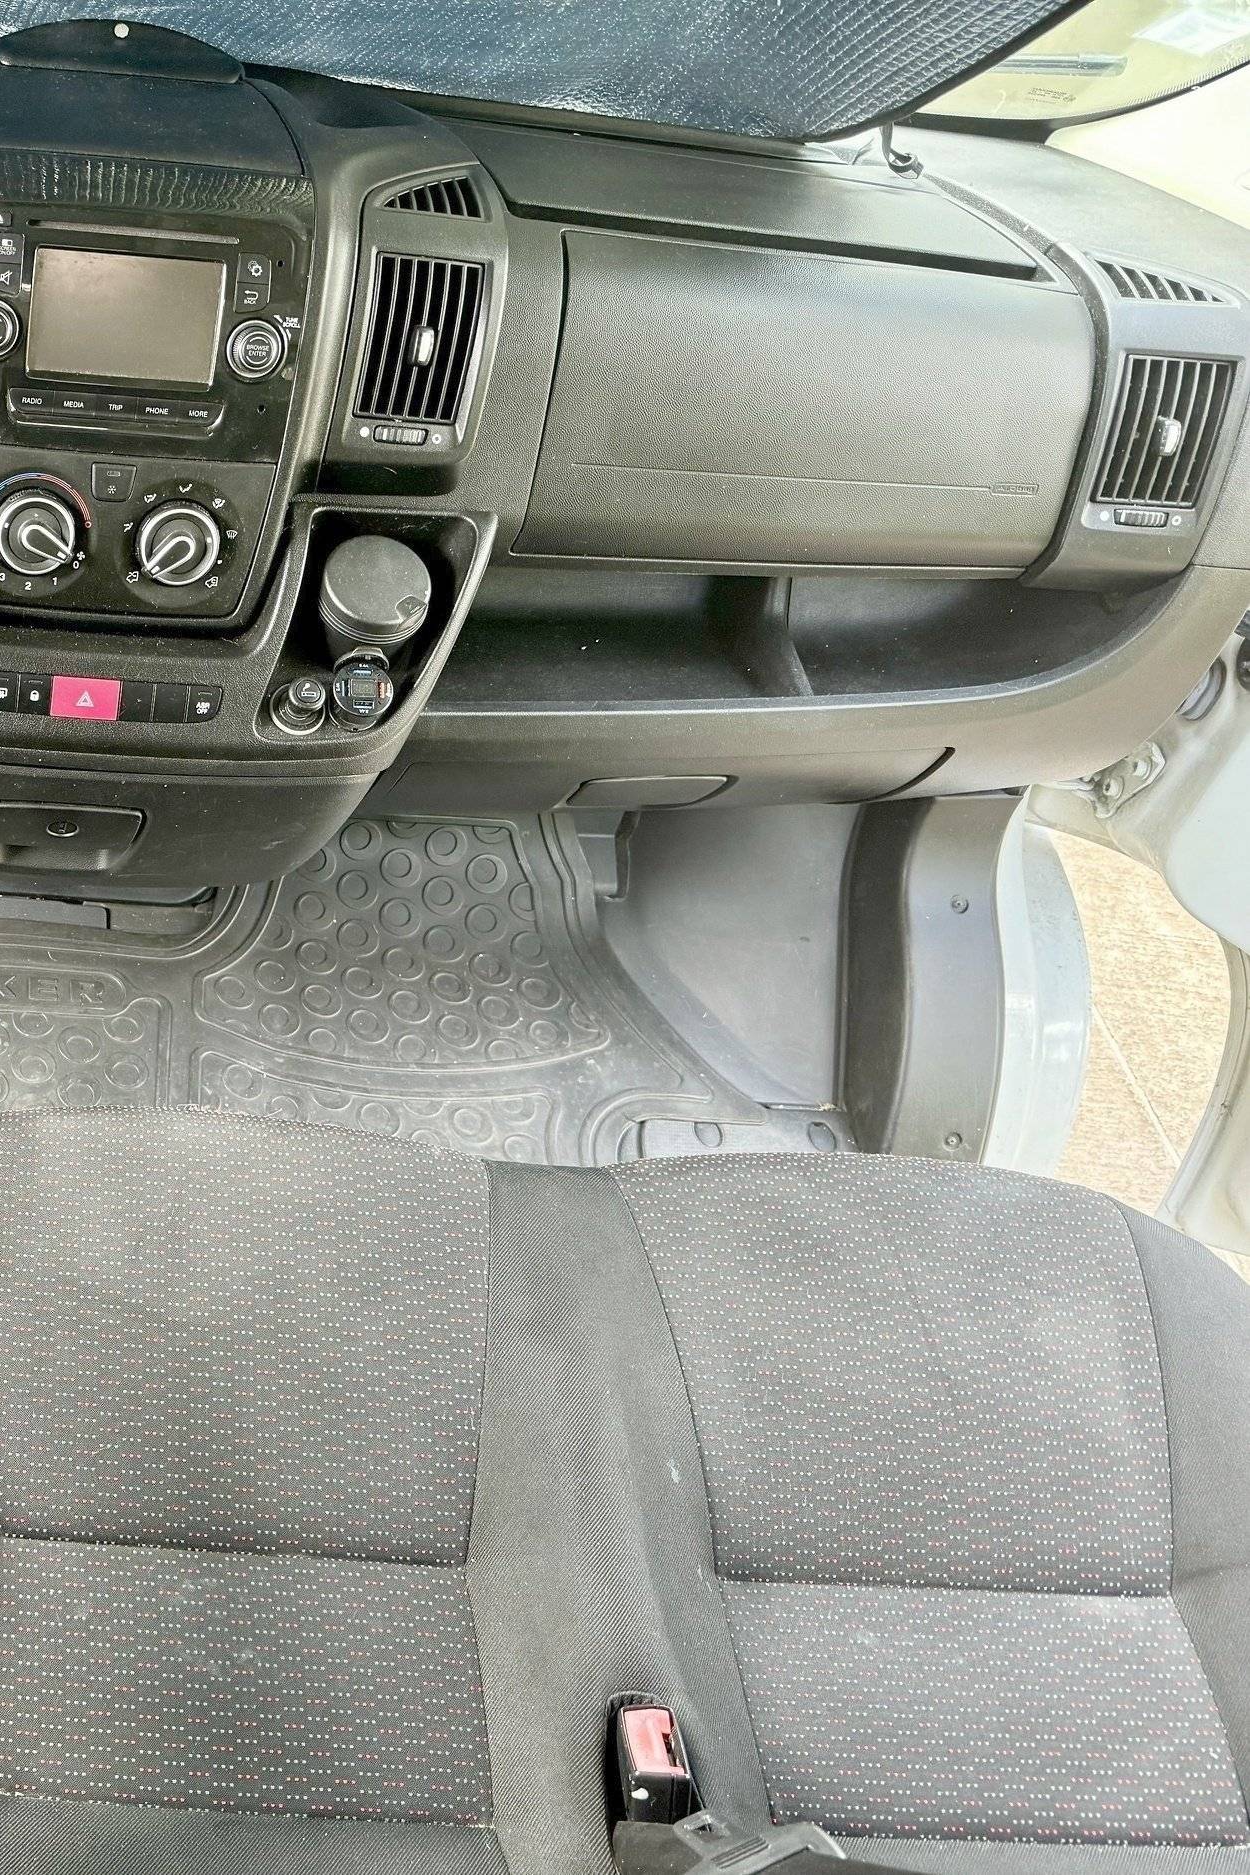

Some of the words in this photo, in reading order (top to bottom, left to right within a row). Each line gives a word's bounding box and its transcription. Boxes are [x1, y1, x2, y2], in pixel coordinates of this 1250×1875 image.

[246, 344, 270, 352] BROWSE
[21, 396, 43, 405] RADIO
[63, 400, 85, 409] MEDIA
[108, 403, 123, 411] TRIP
[145, 406, 169, 415] PHONE
[188, 409, 209, 418] MORE
[72, 560, 80, 569] 0
[52, 576, 58, 586] 1
[24, 581, 32, 591] 2
[196, 701, 210, 709] ASR
